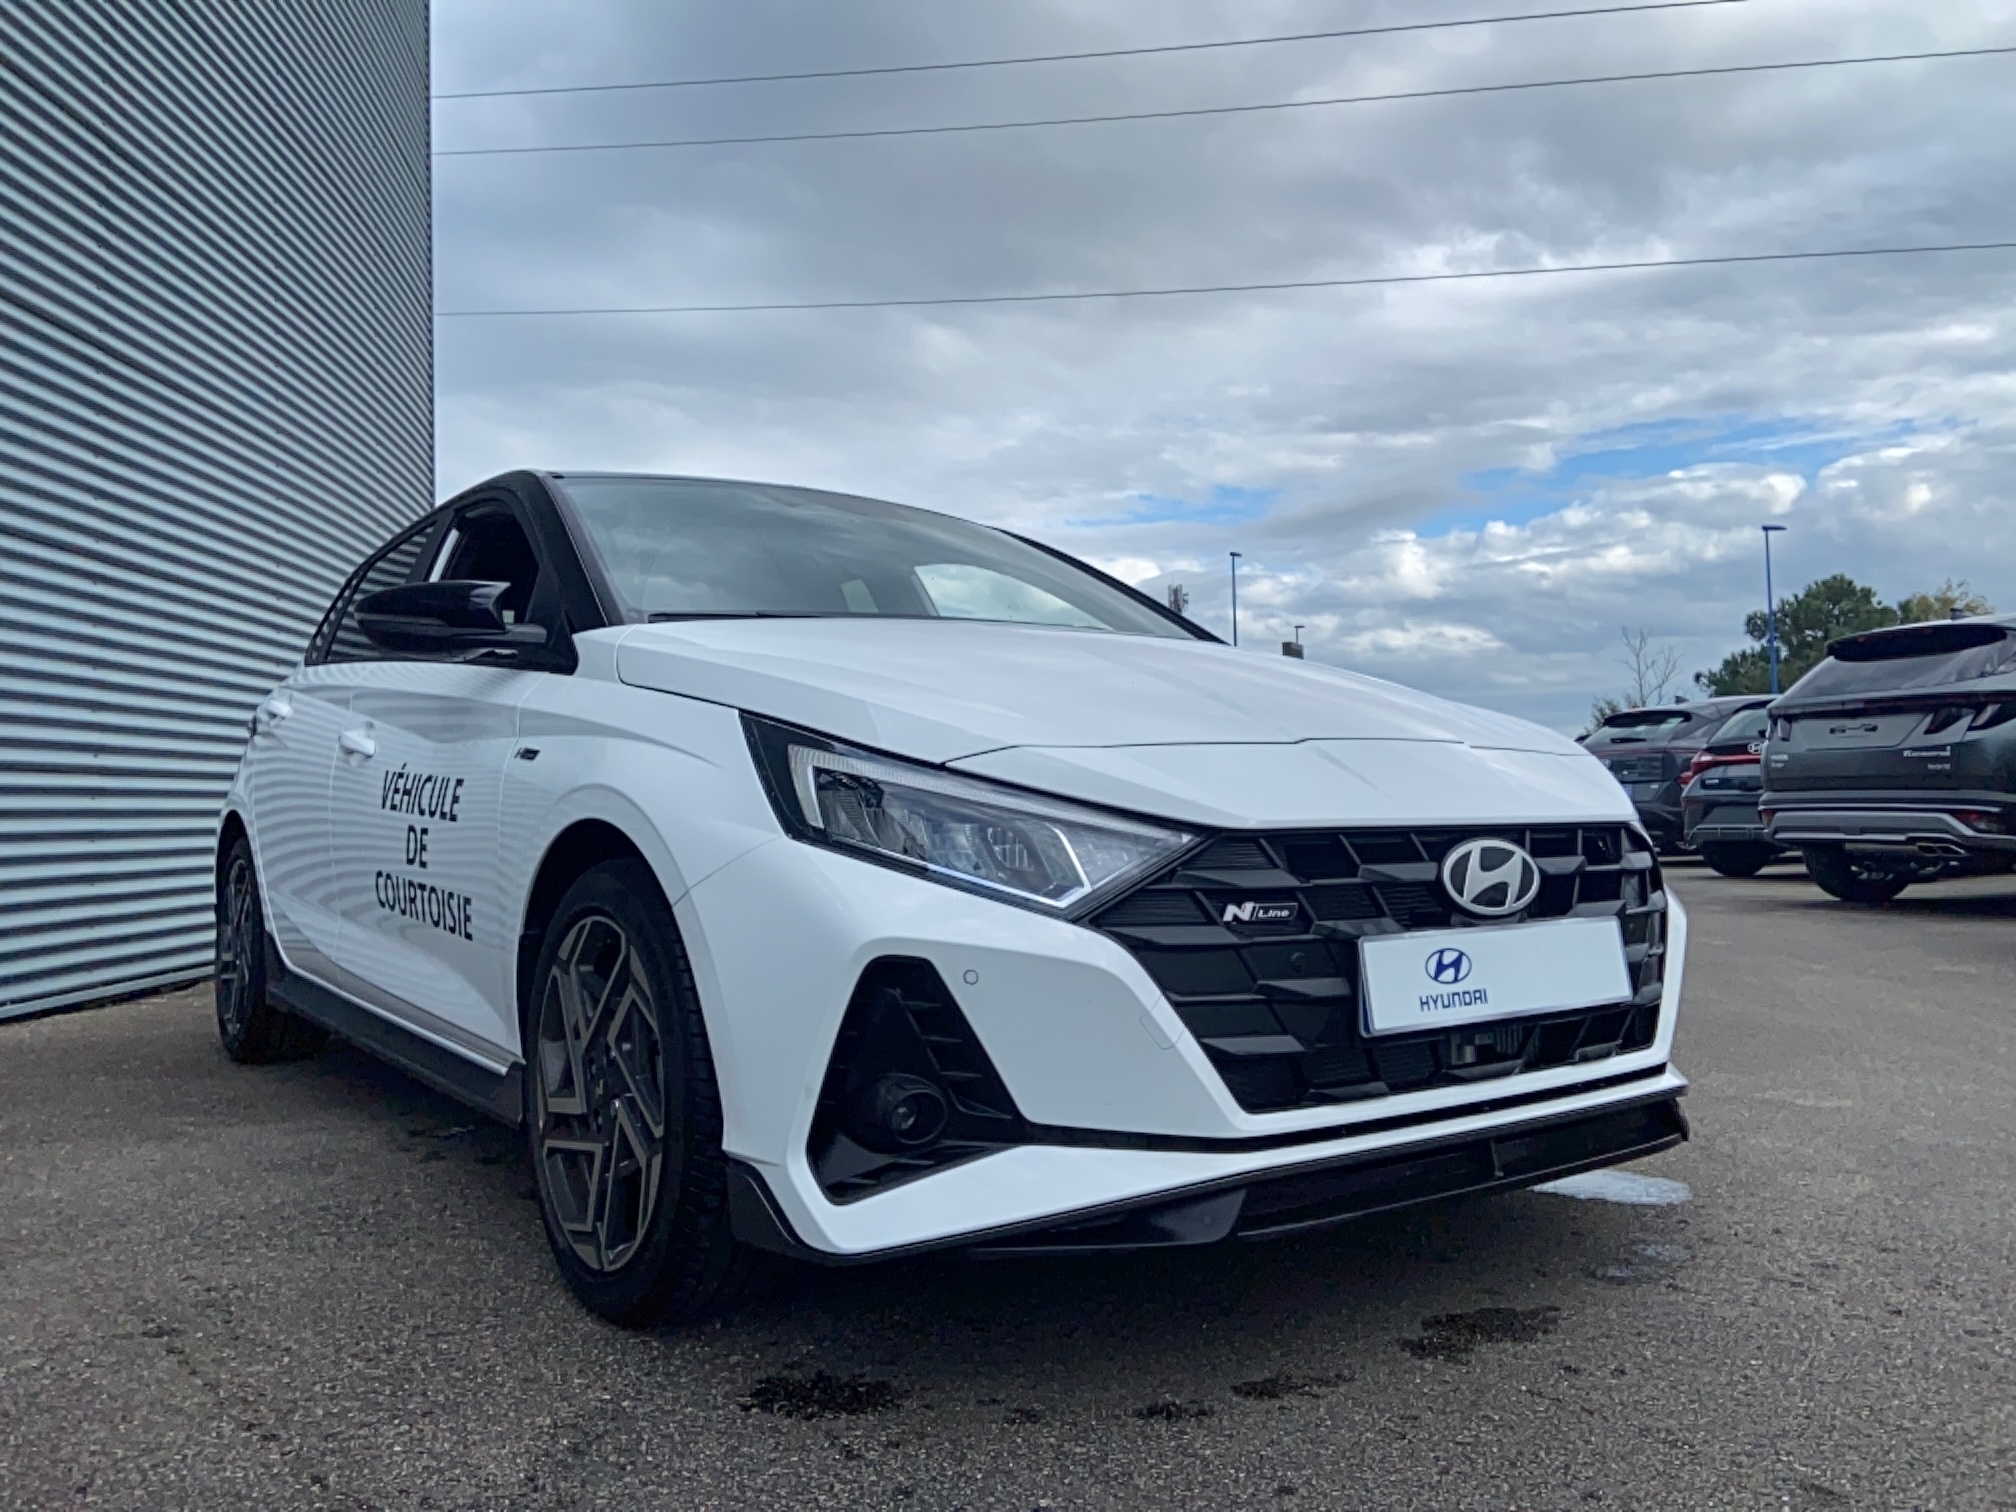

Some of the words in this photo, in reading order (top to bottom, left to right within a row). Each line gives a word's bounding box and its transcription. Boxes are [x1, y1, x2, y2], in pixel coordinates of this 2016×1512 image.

[381, 762, 464, 822] VÉHICULE
[406, 824, 429, 869] DE
[375, 870, 473, 941] COURTOISIE
[1223, 901, 1255, 921] N
[1419, 988, 1489, 1012] HYUNDAI
